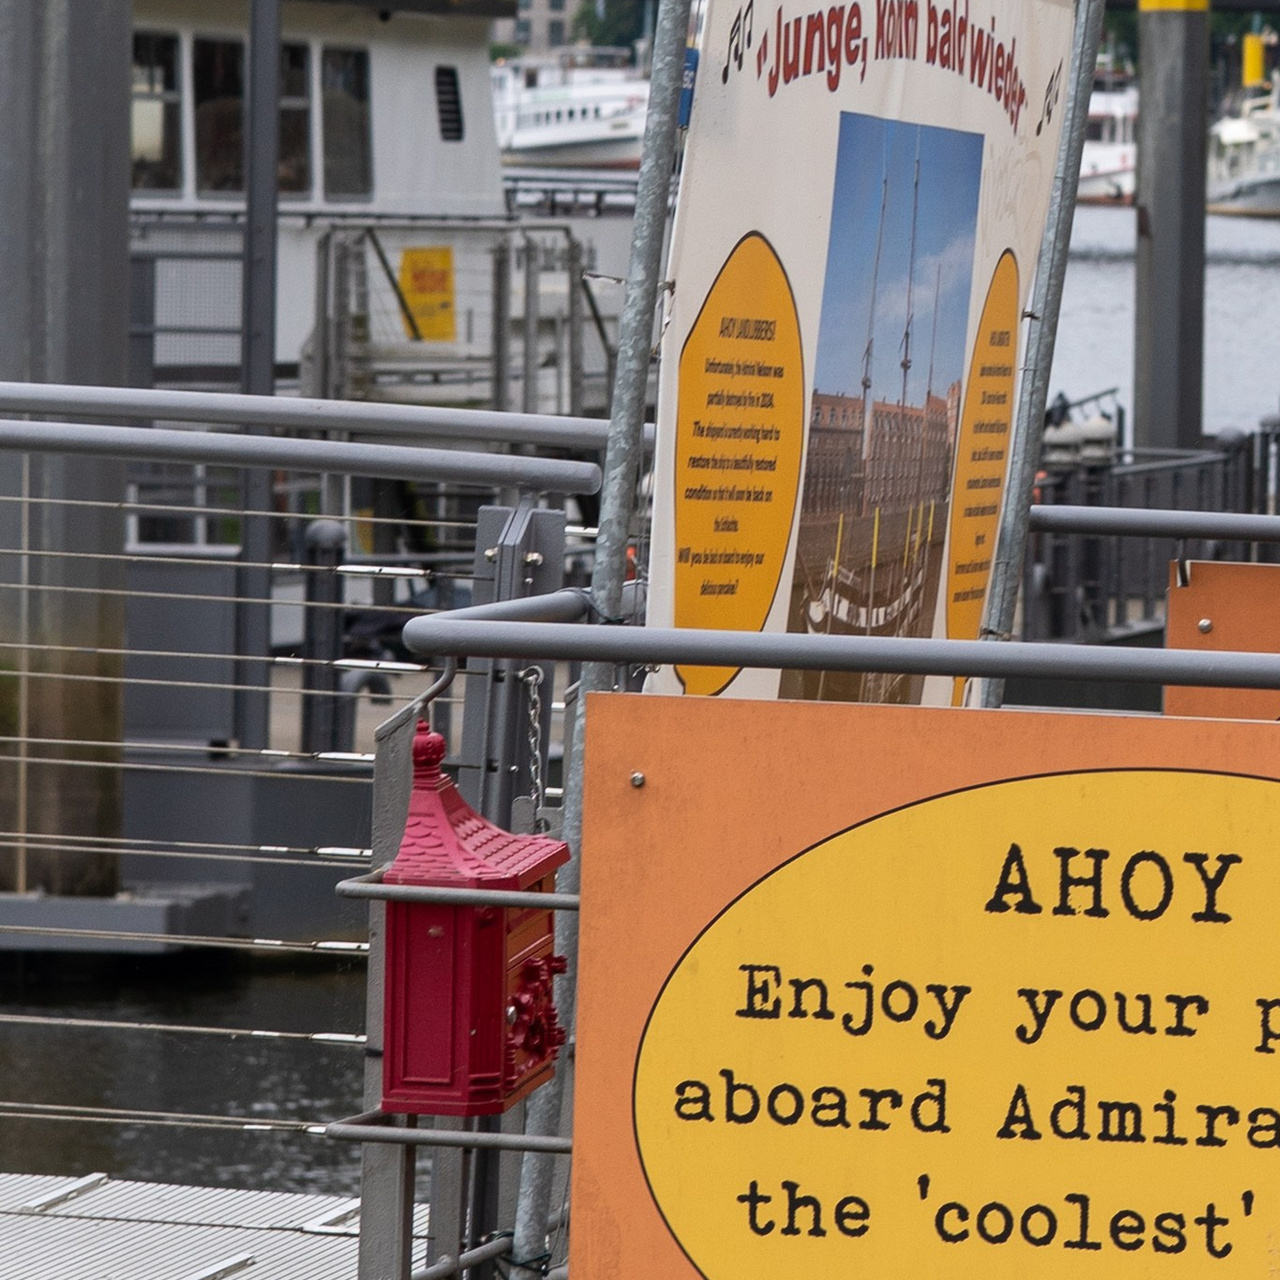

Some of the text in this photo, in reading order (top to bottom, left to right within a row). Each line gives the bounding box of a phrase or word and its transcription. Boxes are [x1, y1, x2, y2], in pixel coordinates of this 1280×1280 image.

[984, 842, 1243, 925] AHOY
[735, 964, 973, 1041] Enjoy
[1015, 988, 1210, 1045] your
[674, 1068, 951, 1134] aboard
[736, 1180, 871, 1238] the
[917, 1173, 1254, 1259] 'coolest'
